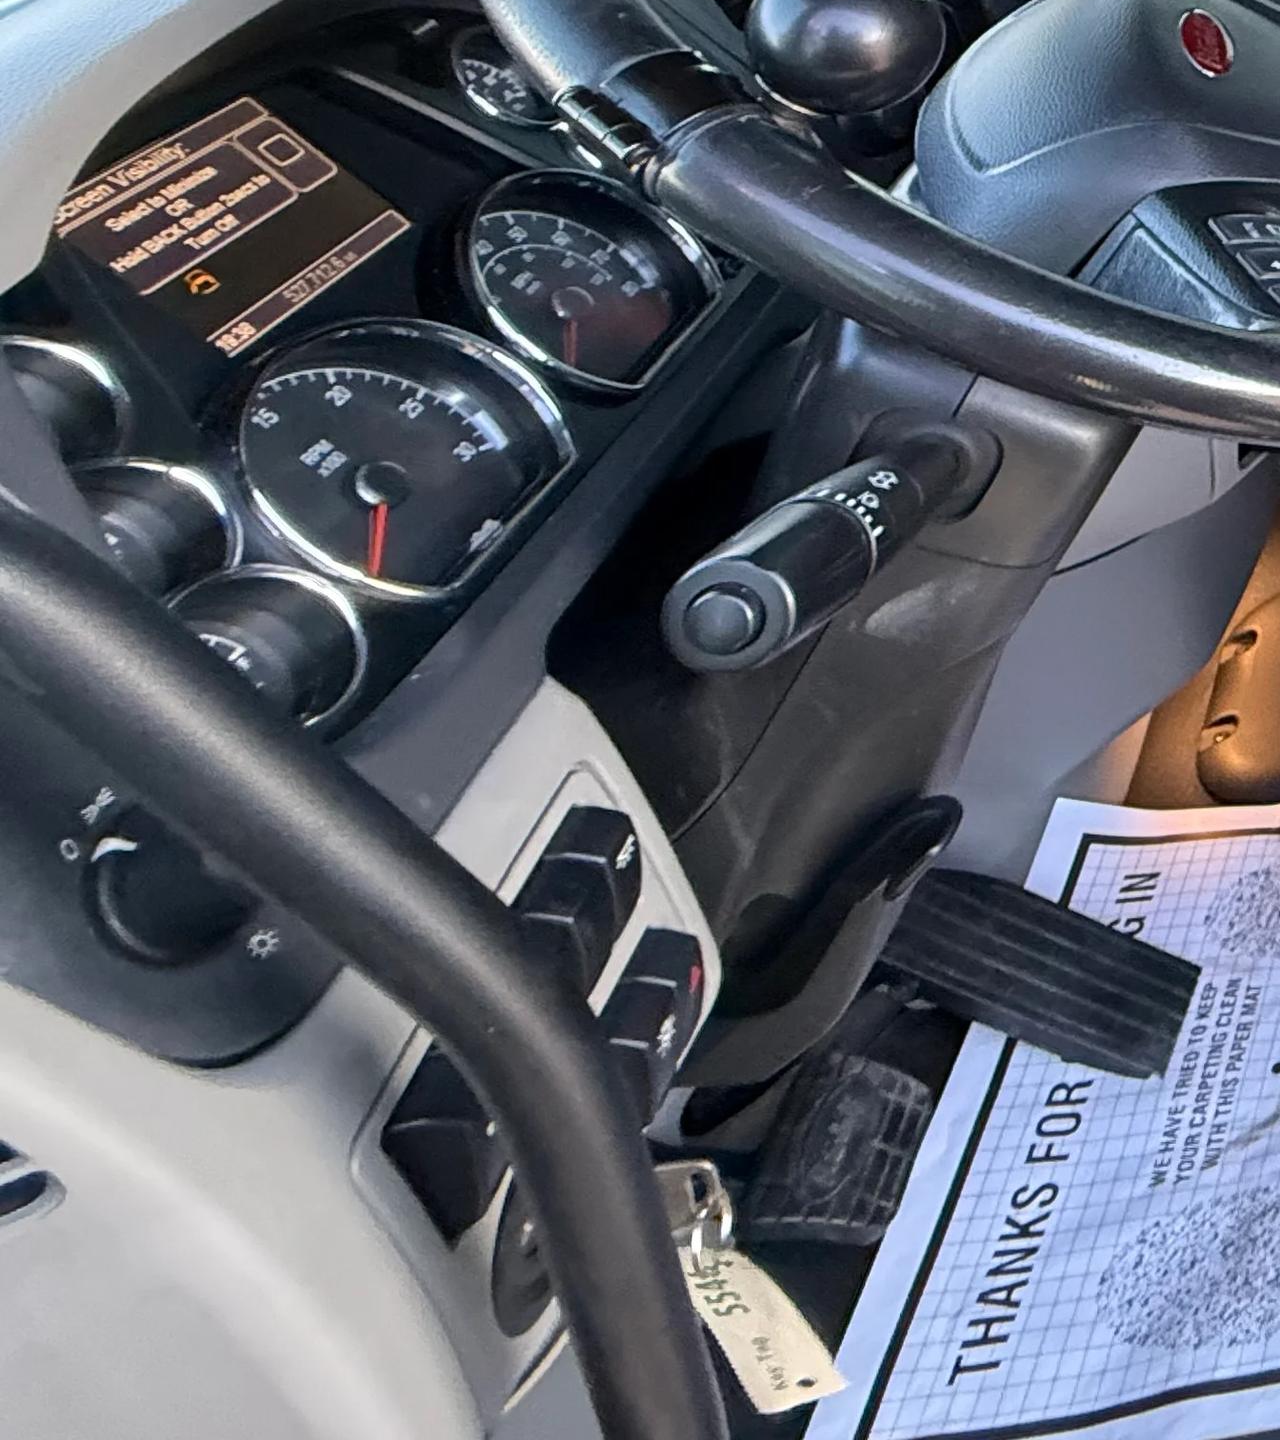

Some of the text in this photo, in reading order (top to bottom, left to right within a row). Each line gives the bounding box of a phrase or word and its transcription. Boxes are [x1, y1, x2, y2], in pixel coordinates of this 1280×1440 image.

[251, 407, 279, 429] 15
[1148, 981, 1219, 1189] WE HAVE TRIED TO KEEP
[1173, 976, 1243, 1186] YOUR CARPETING CLEAN
[1200, 985, 1263, 1173] WITH THIS PAPER MAT
[948, 1181, 1060, 1387] THANKS
[1023, 1078, 1094, 1167] FOR
